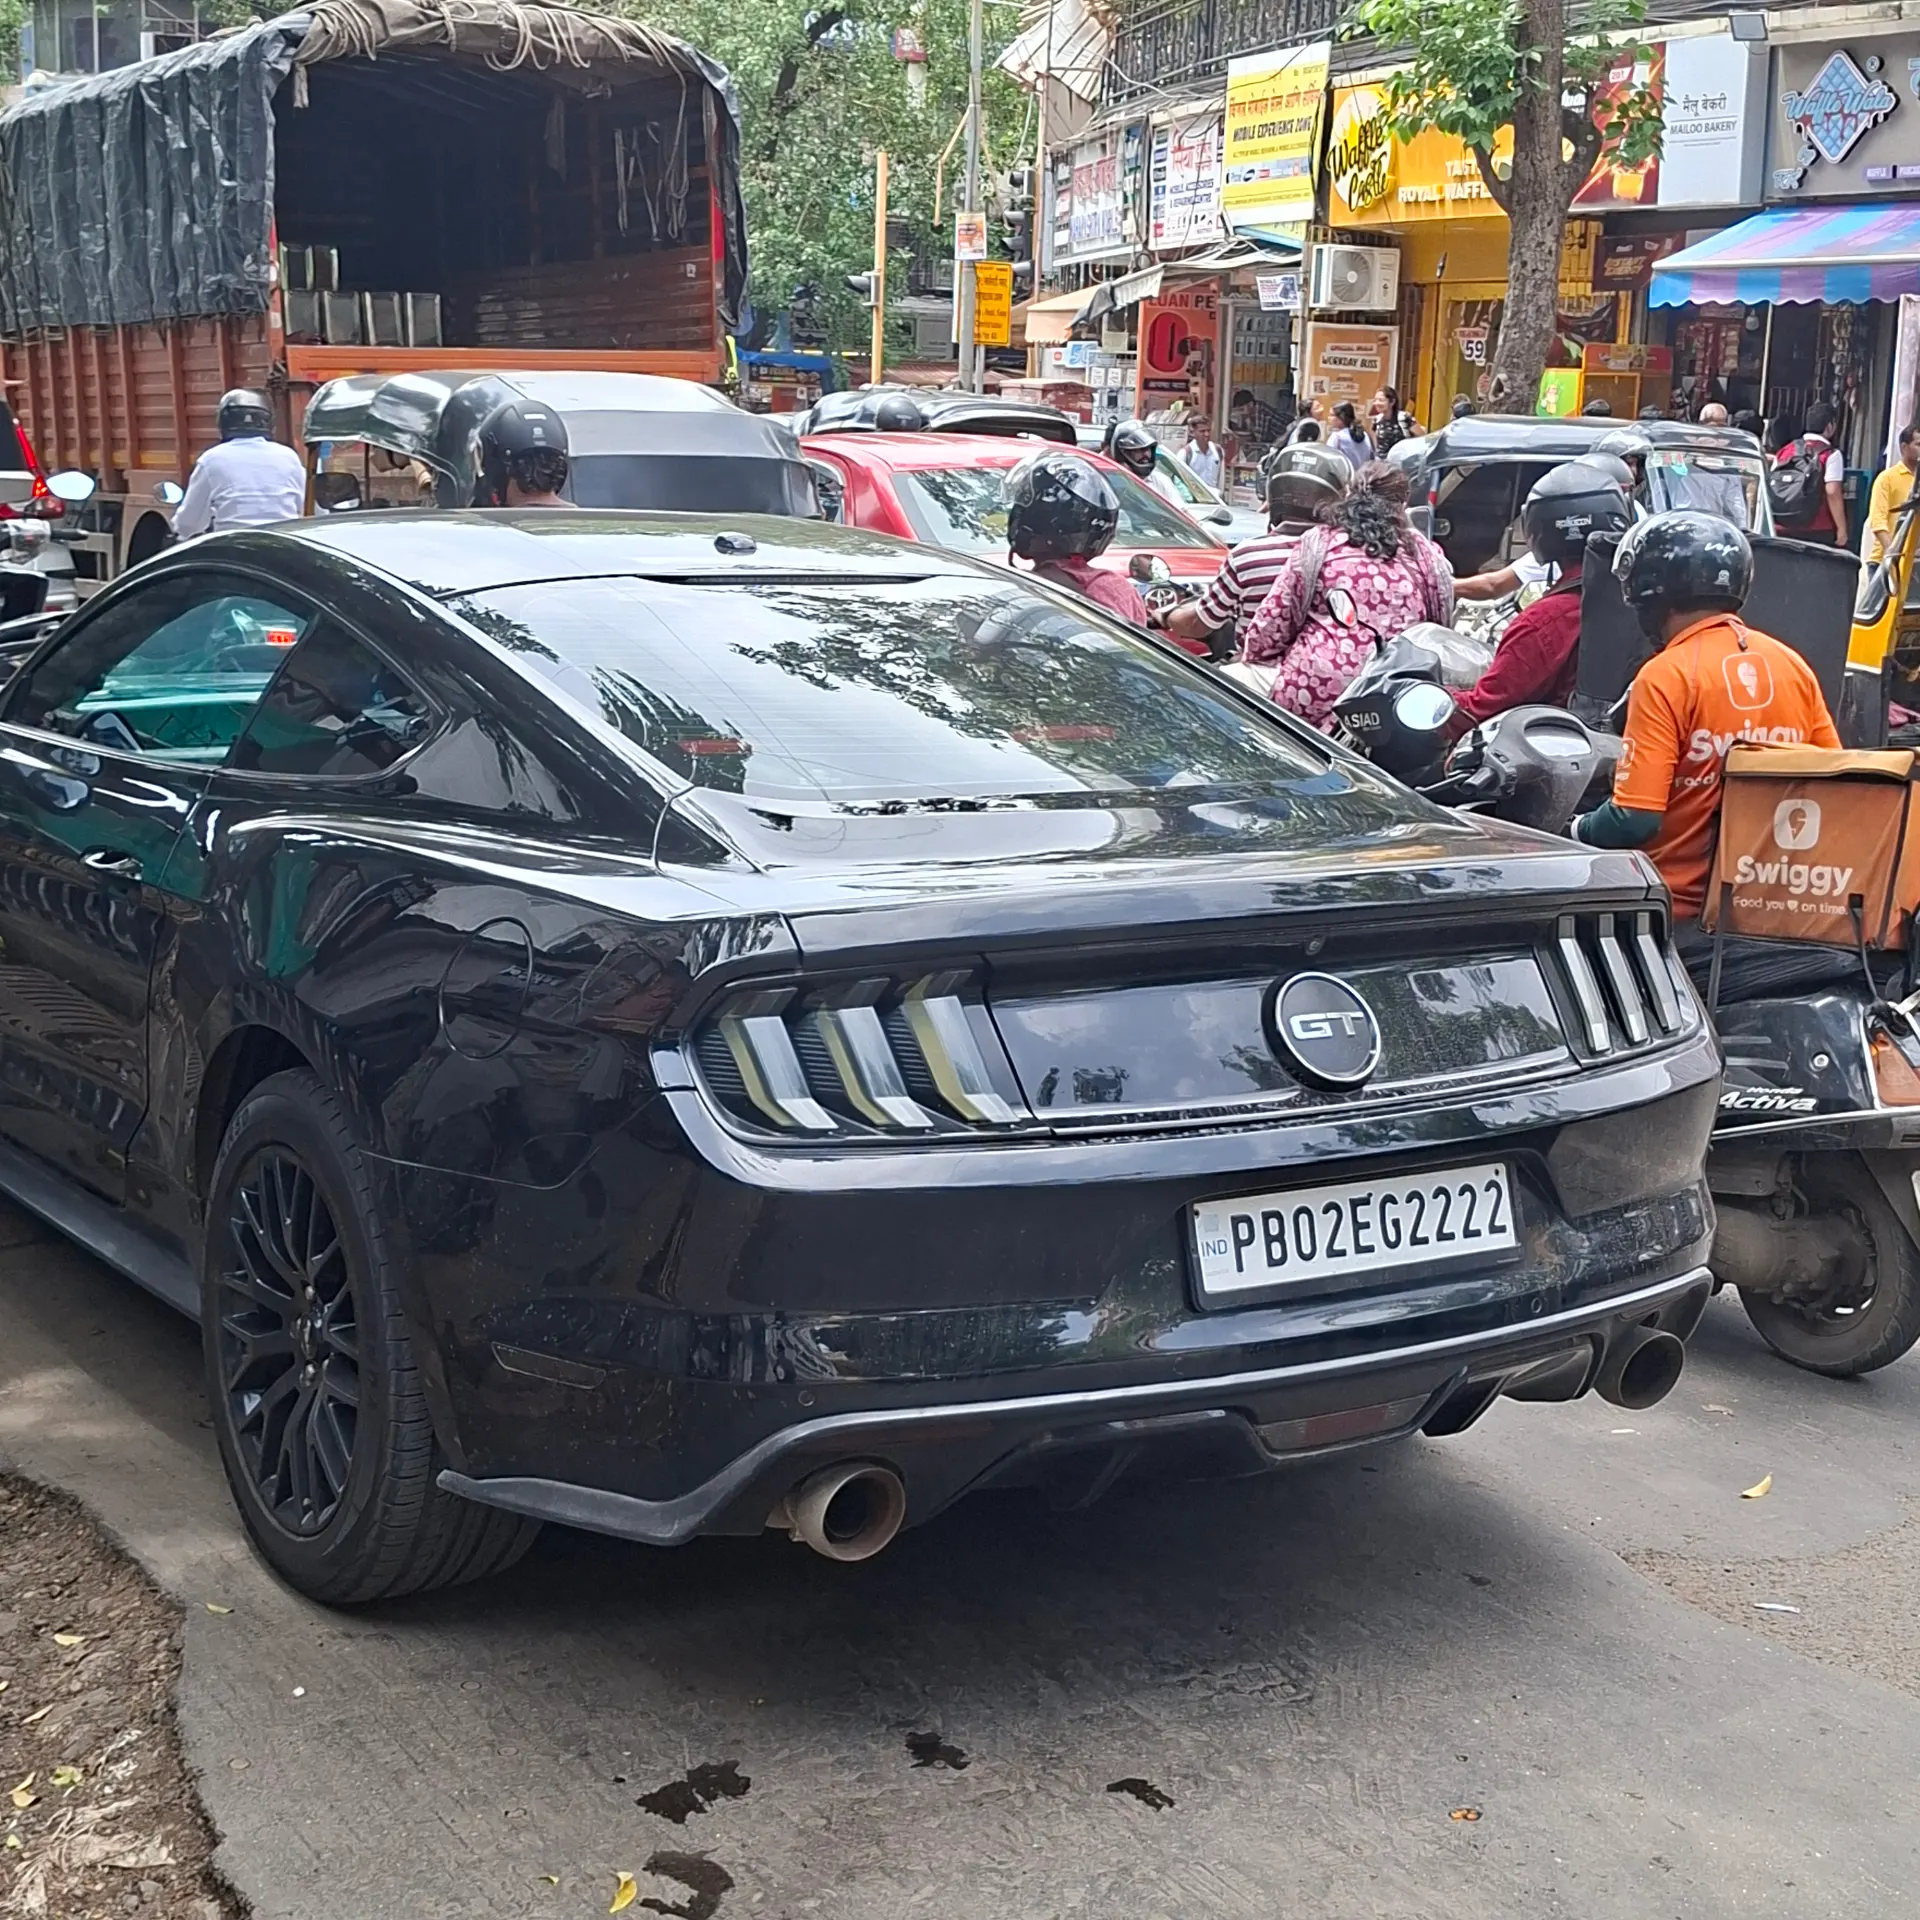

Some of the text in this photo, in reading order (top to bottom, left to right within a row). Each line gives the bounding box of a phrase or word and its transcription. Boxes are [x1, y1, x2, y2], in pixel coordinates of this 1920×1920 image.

[1233, 125, 1256, 142] MOBILE
[1257, 118, 1294, 138] EXPERIENCE
[1670, 121, 1737, 135] MAILOO BAKERY
[1326, 117, 1385, 183] Waffle
[1445, 159, 1482, 177] TAST
[1348, 151, 1388, 213] Castle
[1398, 181, 1492, 203] ROYAL WAFFL
[1194, 294, 1214, 309] PE
[1465, 340, 1484, 358] 59
[1734, 855, 1853, 897] Swiggy
[1733, 896, 1763, 909] Food
[1765, 898, 1786, 912] you
[1801, 903, 1817, 912] on
[1289, 1011, 1364, 1039] GT
[1746, 1086, 1804, 1094] Honda
[1719, 1091, 1817, 1111] Activa
[1201, 1179, 1507, 1273] IND PB02EG2222
